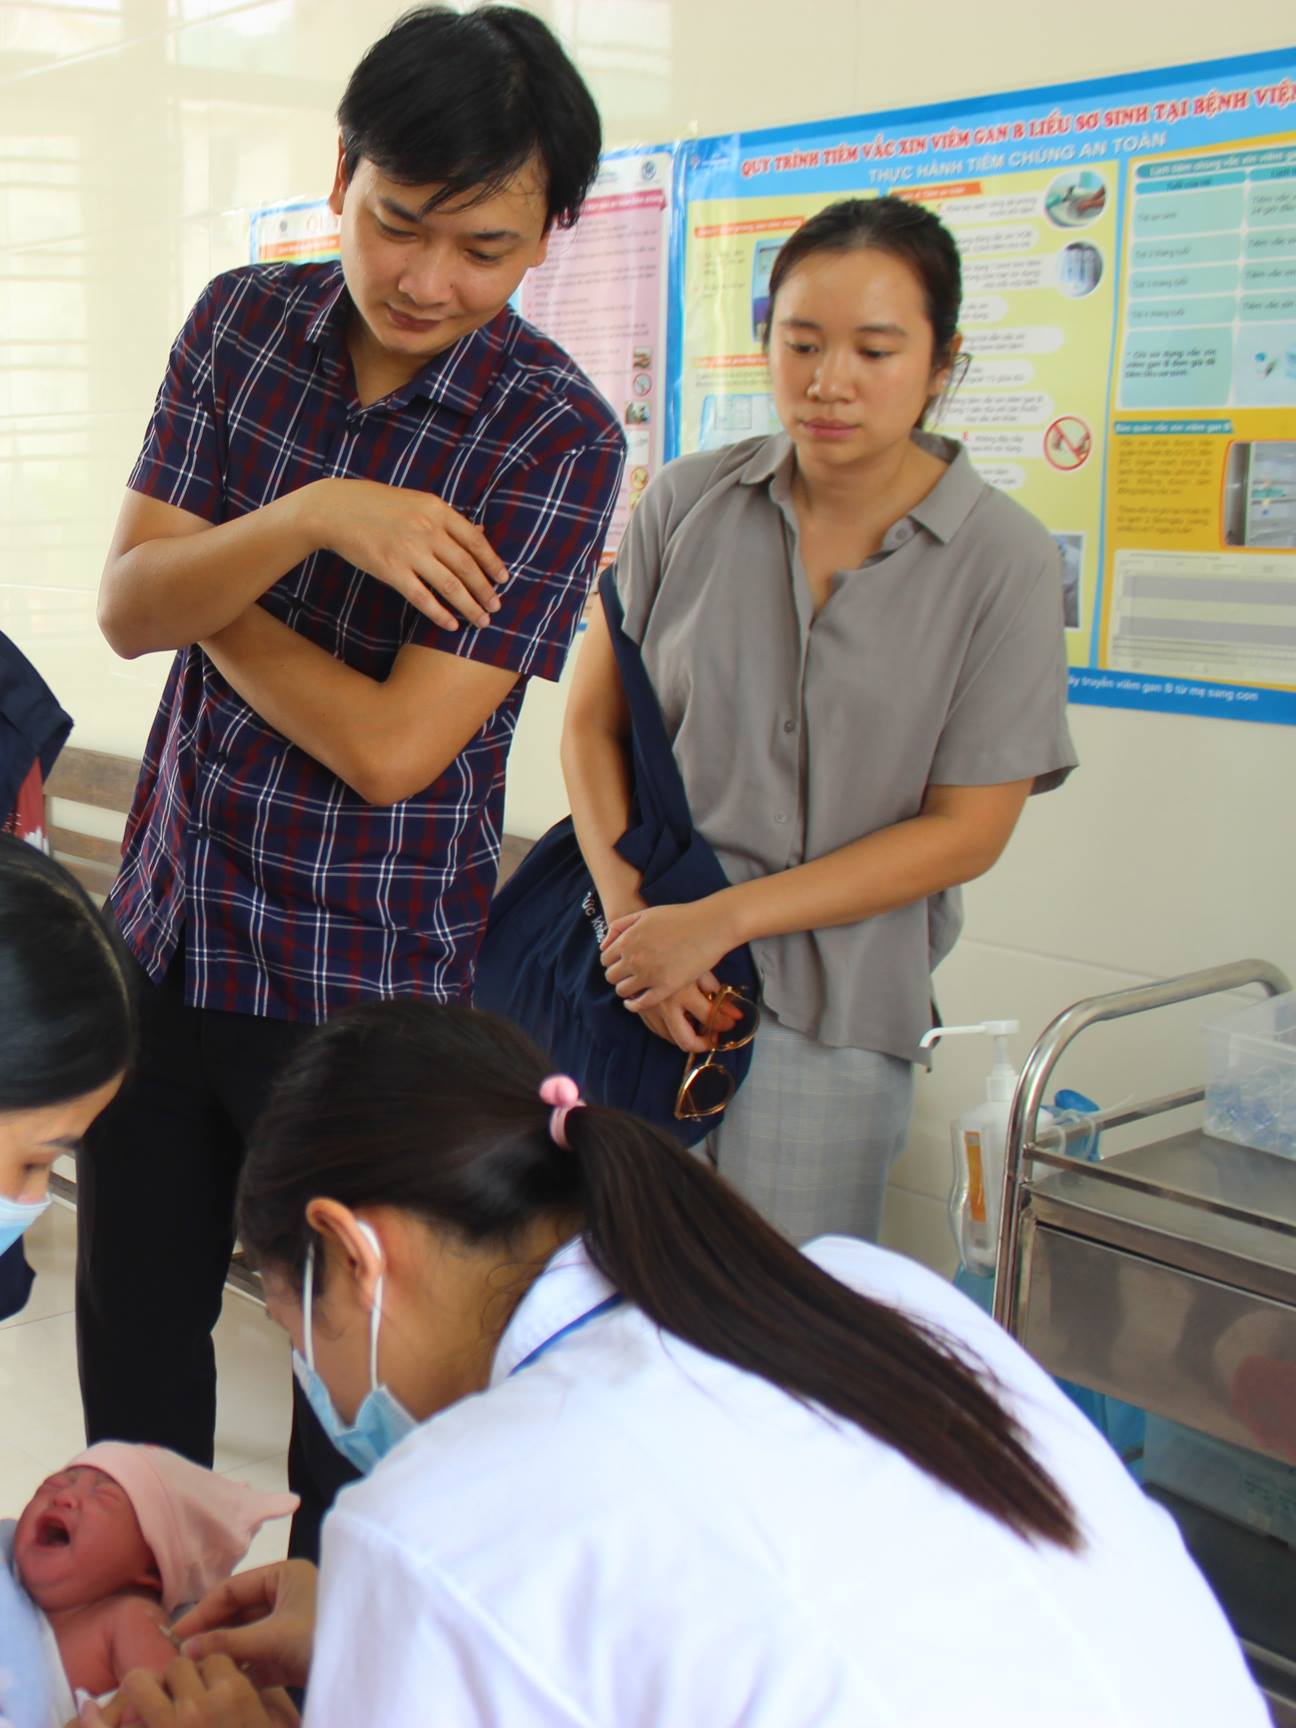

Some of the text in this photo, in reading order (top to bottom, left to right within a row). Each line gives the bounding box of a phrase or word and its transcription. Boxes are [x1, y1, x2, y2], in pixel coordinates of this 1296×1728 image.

[741, 157, 772, 178] QUY
[775, 148, 819, 172] TRÌNH
[823, 142, 859, 165] TIÊM
[898, 137, 928, 155] XIN
[931, 127, 970, 150] VIÊM
[973, 124, 1008, 145] GAN
[1012, 122, 1025, 139] B
[1103, 105, 1149, 128] SINH
[1153, 98, 1189, 125] TẠI
[1193, 88, 1250, 119] BỆNH
[1079, 140, 1108, 159] AN
[1111, 130, 1167, 153] TOÀN
[1142, 682, 1162, 695] gan
[1208, 689, 1235, 702] sang
[1235, 690, 1259, 702] con
